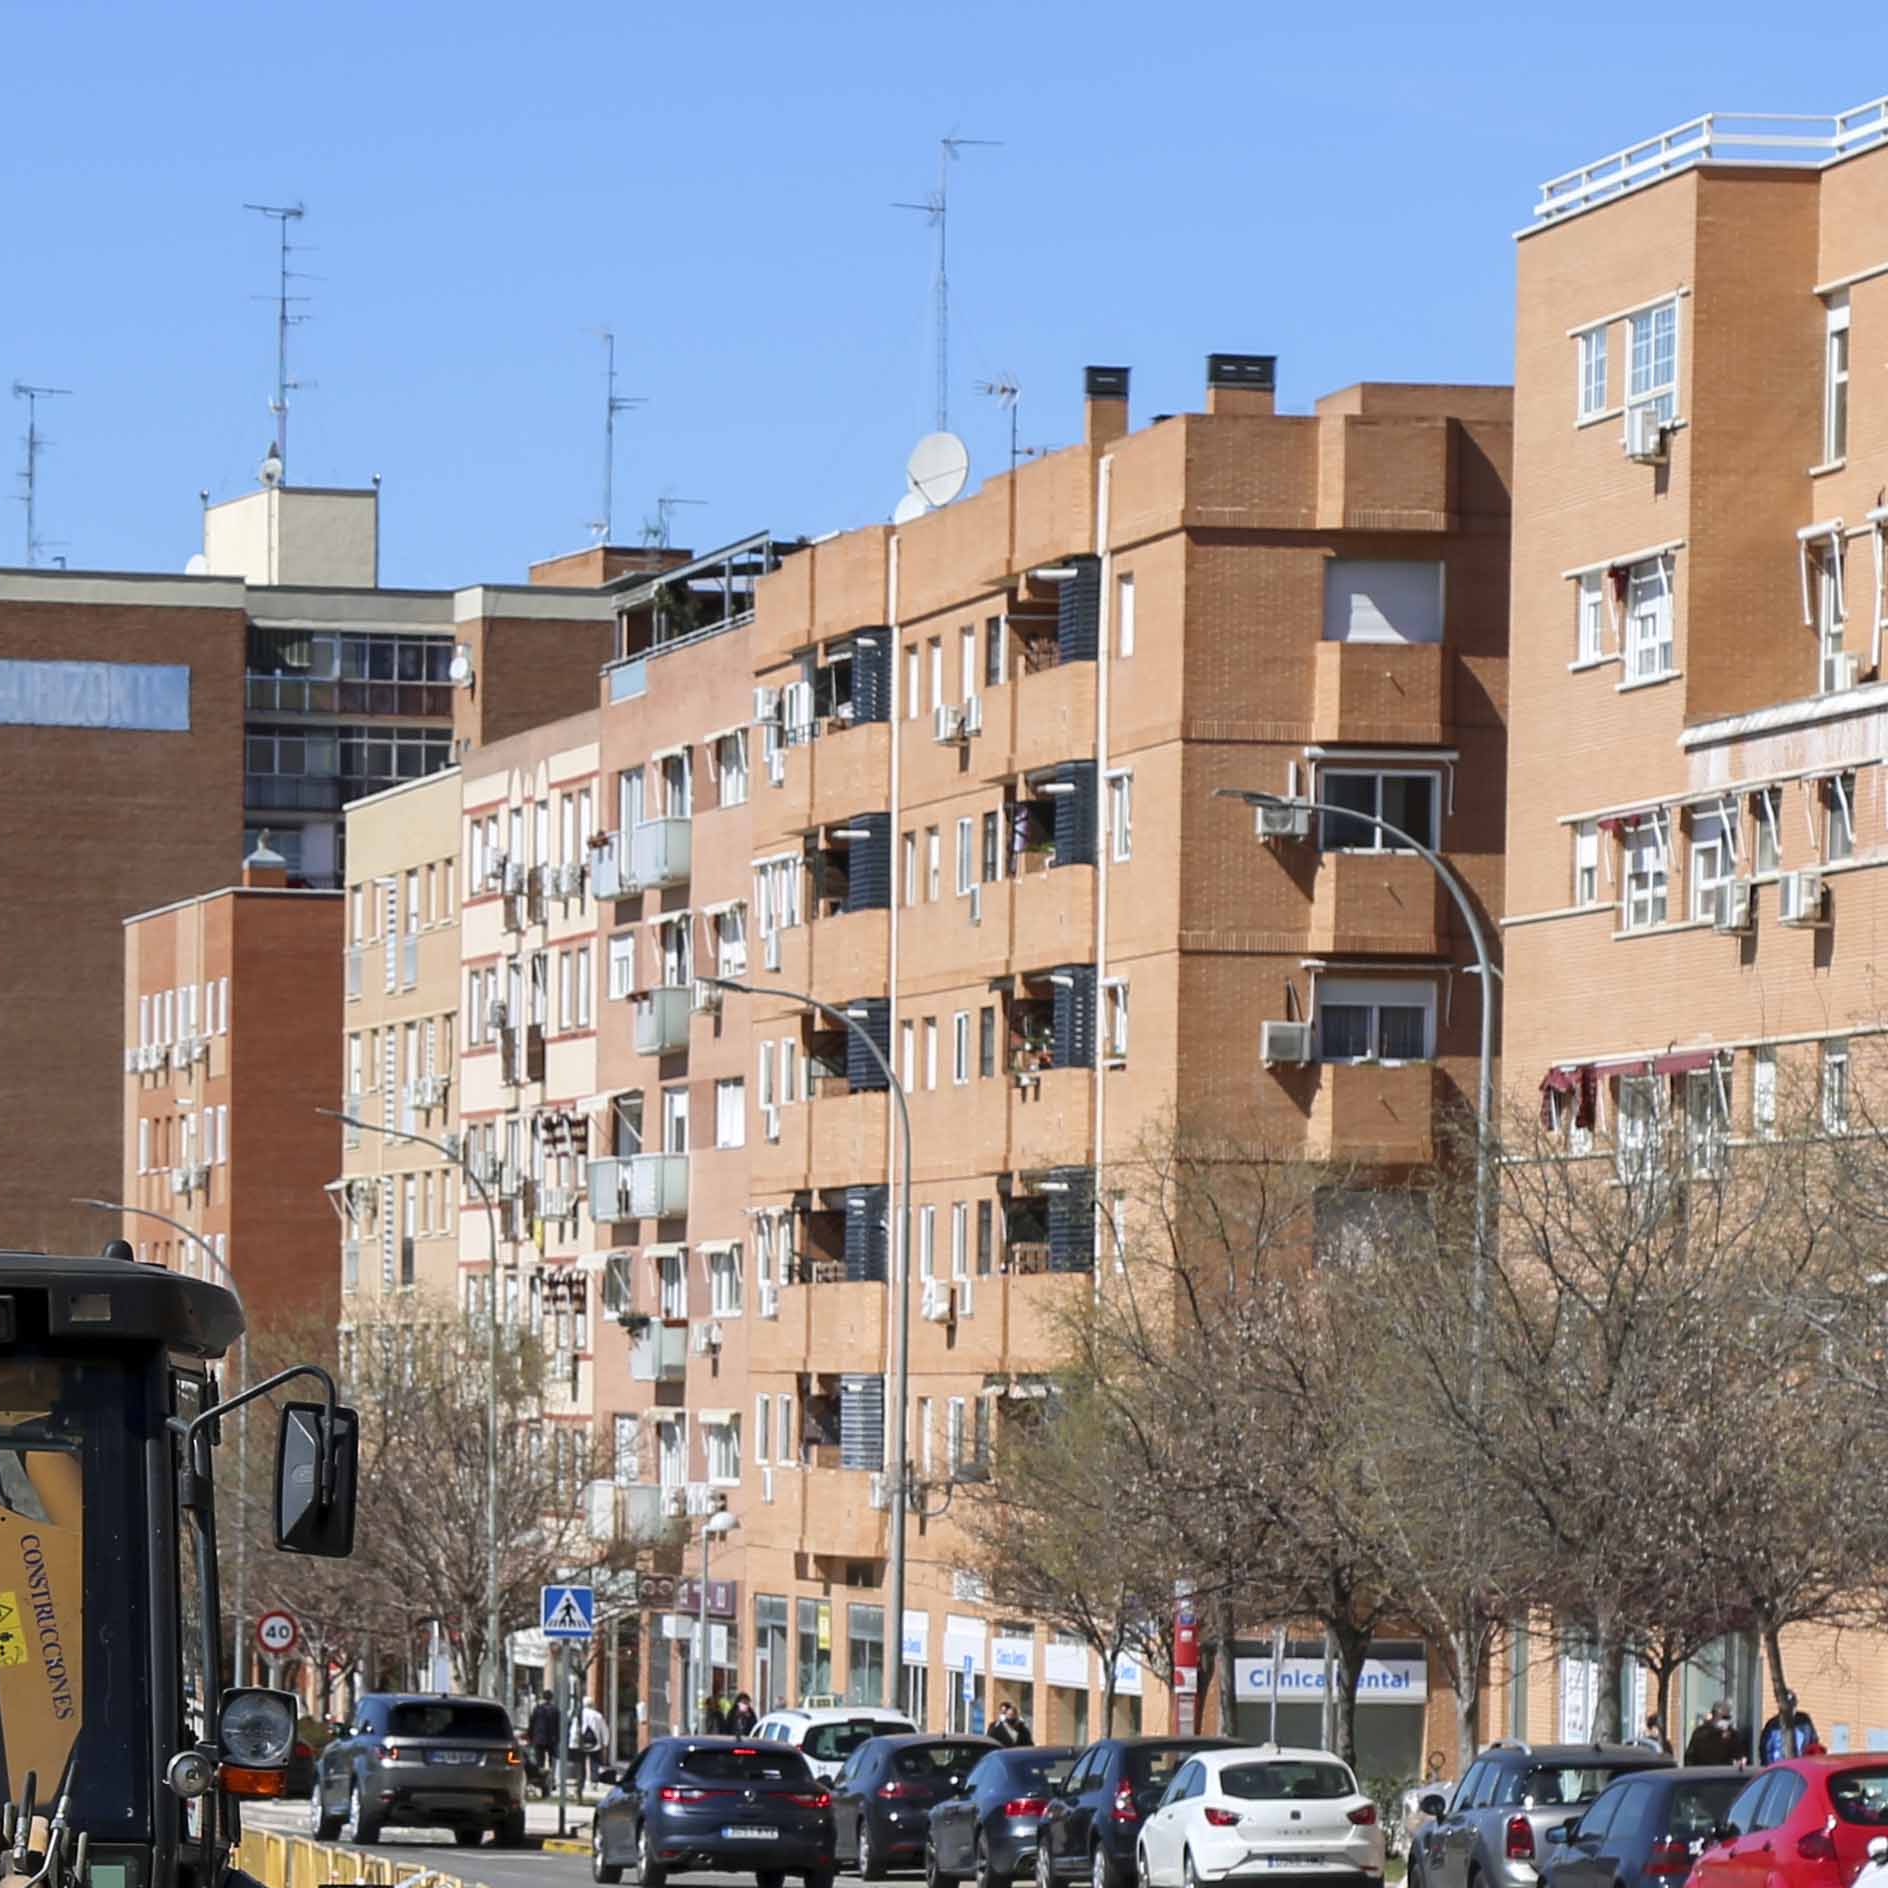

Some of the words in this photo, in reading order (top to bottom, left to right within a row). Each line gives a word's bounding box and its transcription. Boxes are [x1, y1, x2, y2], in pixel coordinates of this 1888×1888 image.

[19, 1533, 74, 1721] CONSTRUCCIONES
[265, 1625, 290, 1639] 40
[1249, 1668, 1328, 1688] Clnica
[1336, 1668, 1410, 1689] ental
